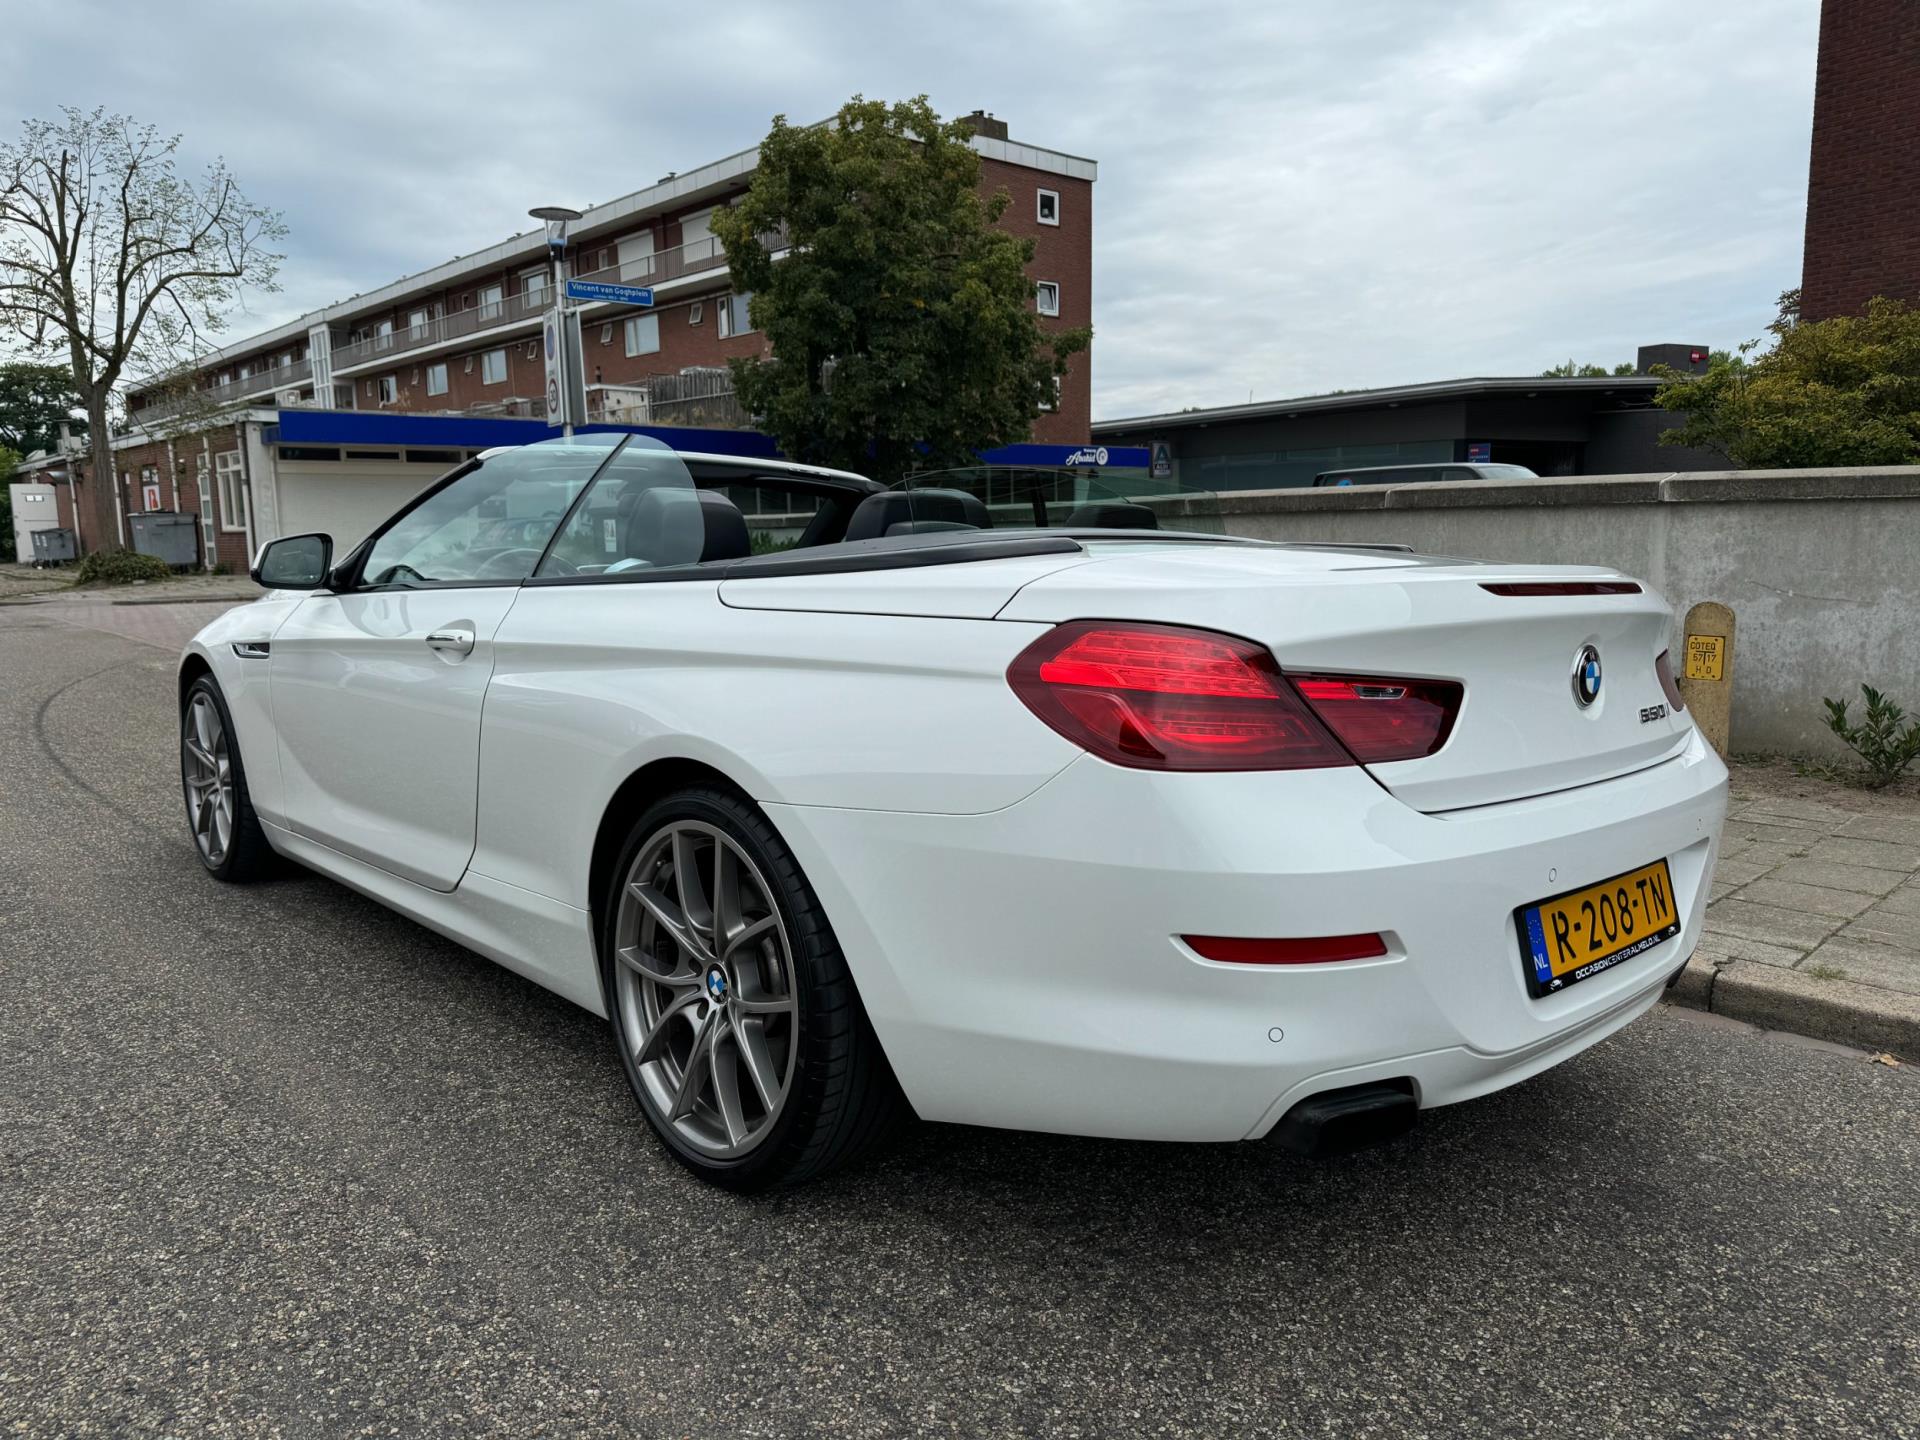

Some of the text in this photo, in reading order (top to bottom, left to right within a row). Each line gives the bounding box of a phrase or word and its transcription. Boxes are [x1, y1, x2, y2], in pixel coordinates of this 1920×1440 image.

[572, 283, 649, 297] Vincent van Goghplein
[550, 389, 557, 402] 30
[1693, 653, 1717, 663] 57 17
[1551, 872, 1668, 964] R-208-TN
[1533, 953, 1549, 972] NL
